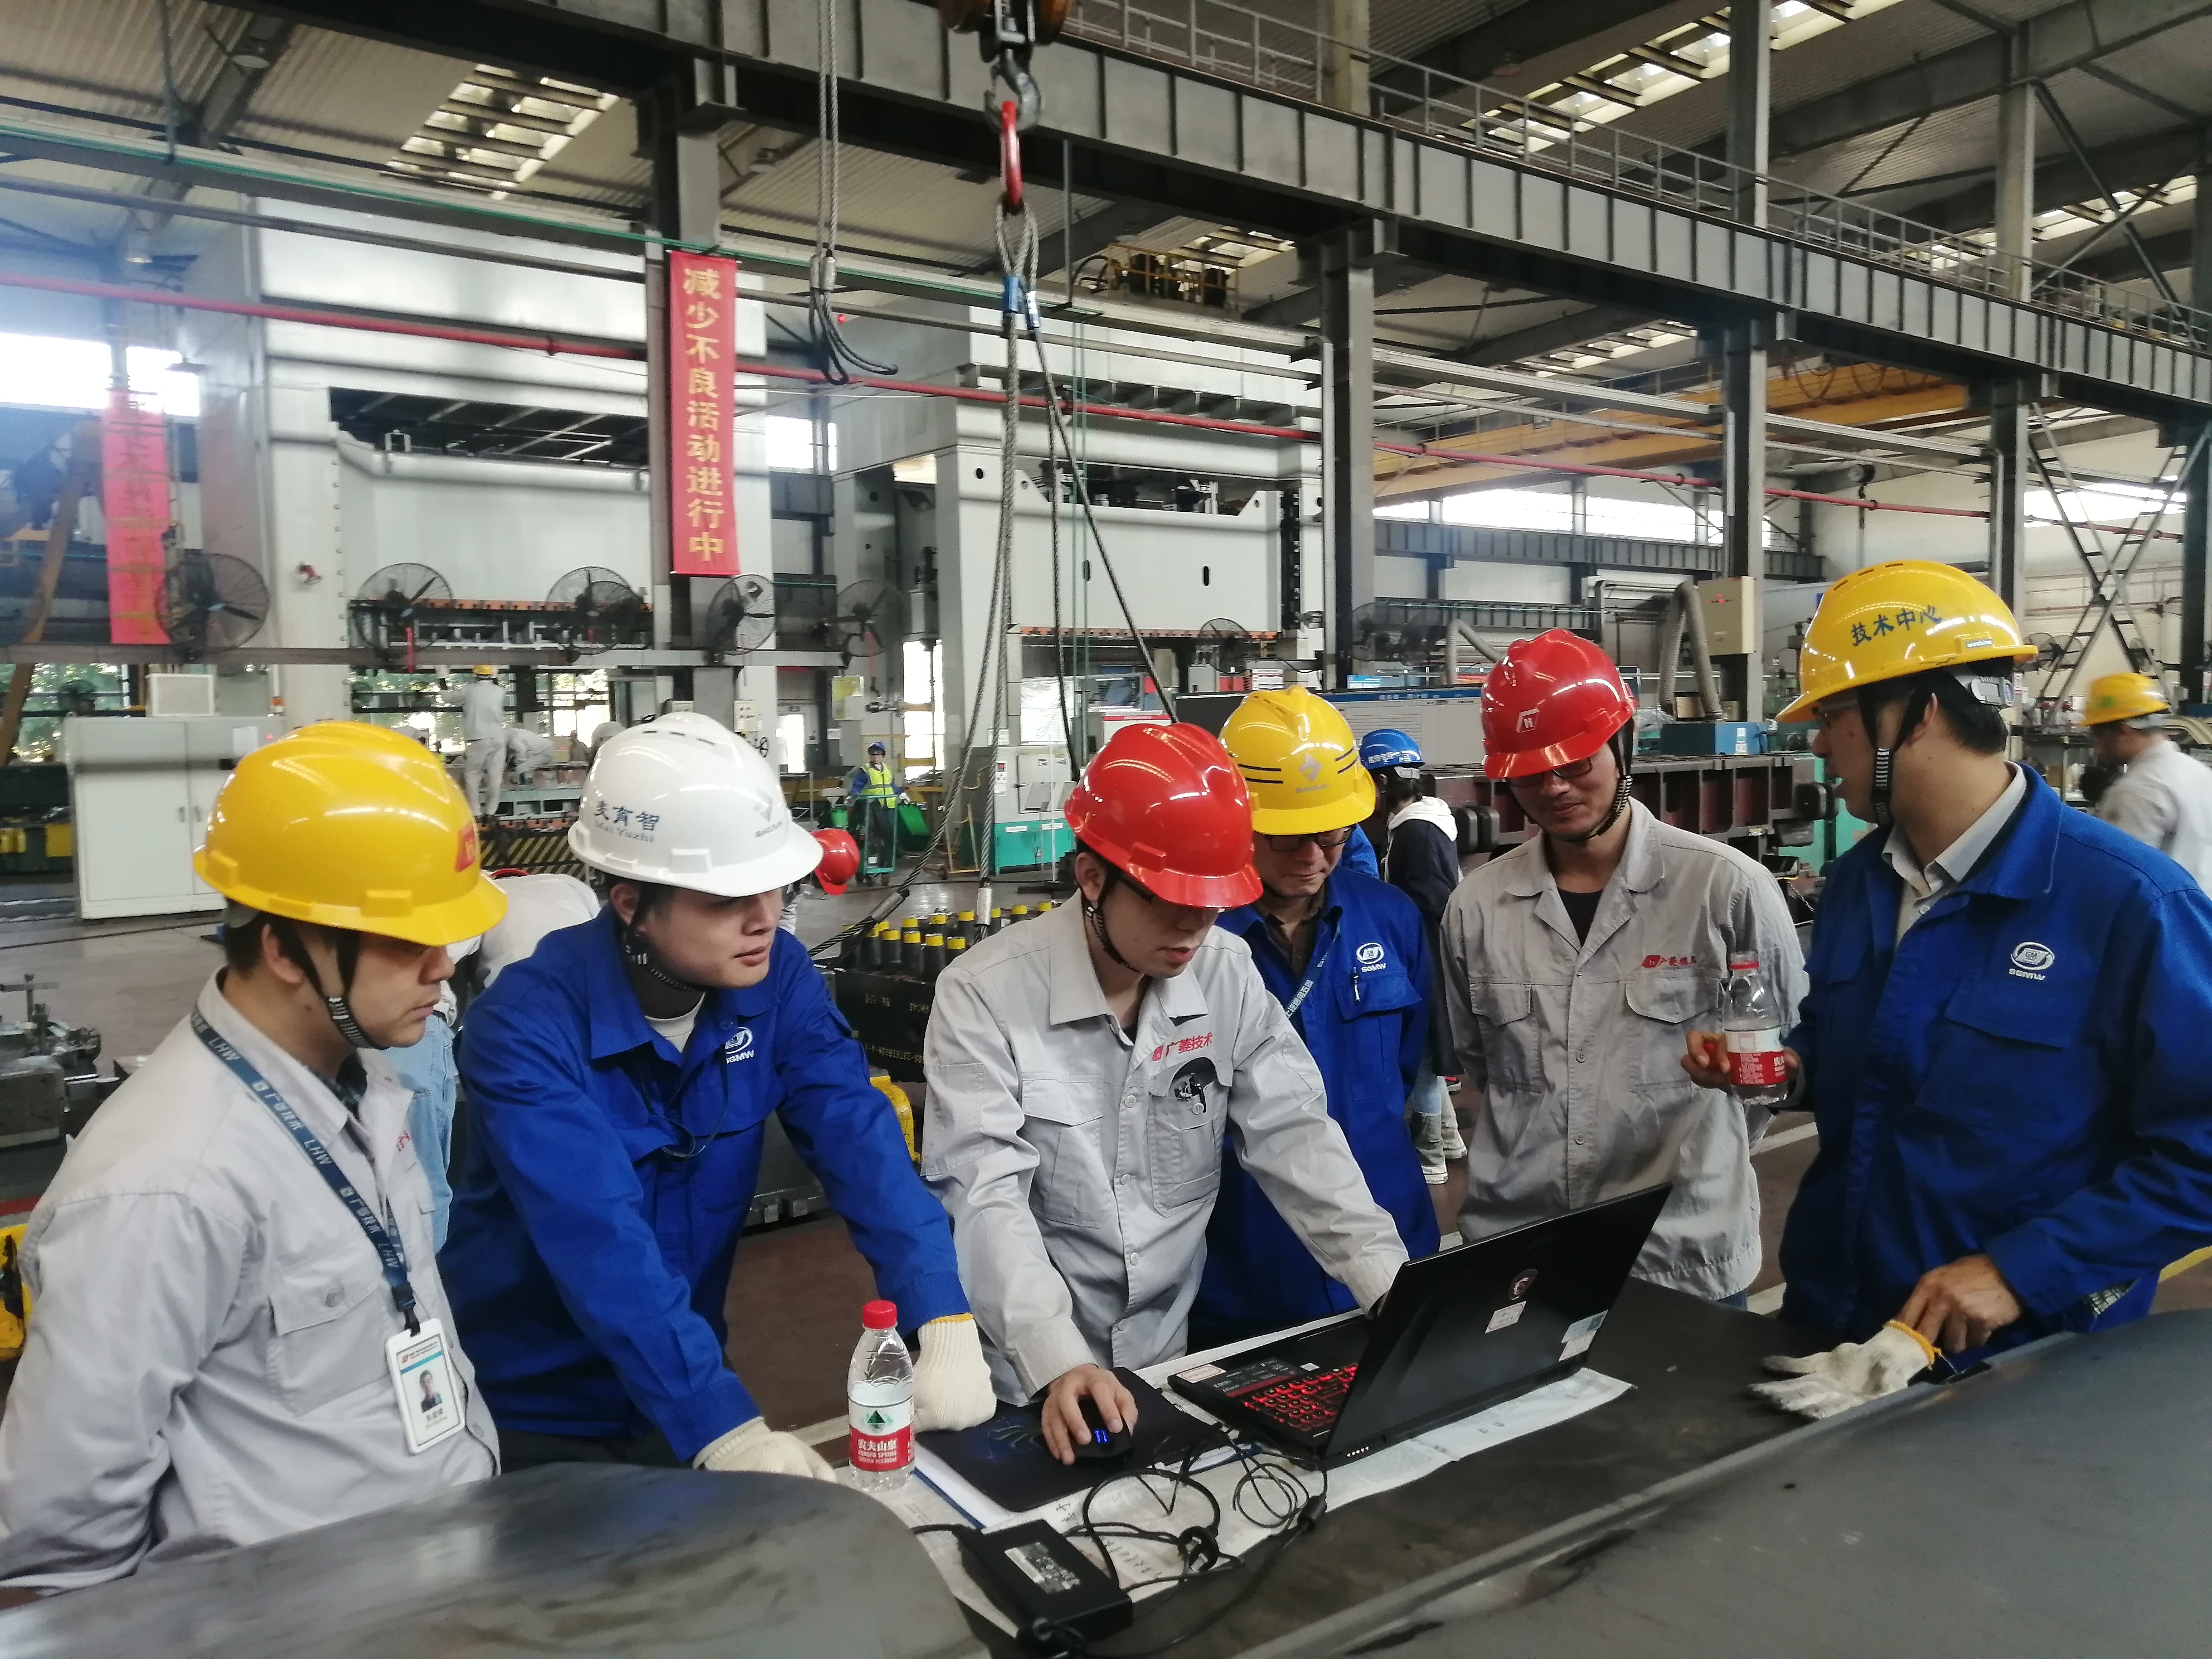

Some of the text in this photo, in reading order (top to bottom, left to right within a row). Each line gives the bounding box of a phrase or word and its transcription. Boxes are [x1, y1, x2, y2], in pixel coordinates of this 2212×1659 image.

[683, 267, 725, 562] 减少不良活动进行中
[1851, 605, 1942, 647] 技术中心
[1361, 963, 1386, 973] SGMW
[2009, 968, 2046, 981] SGMW
[857, 1438, 897, 1451] 农夫山泉
